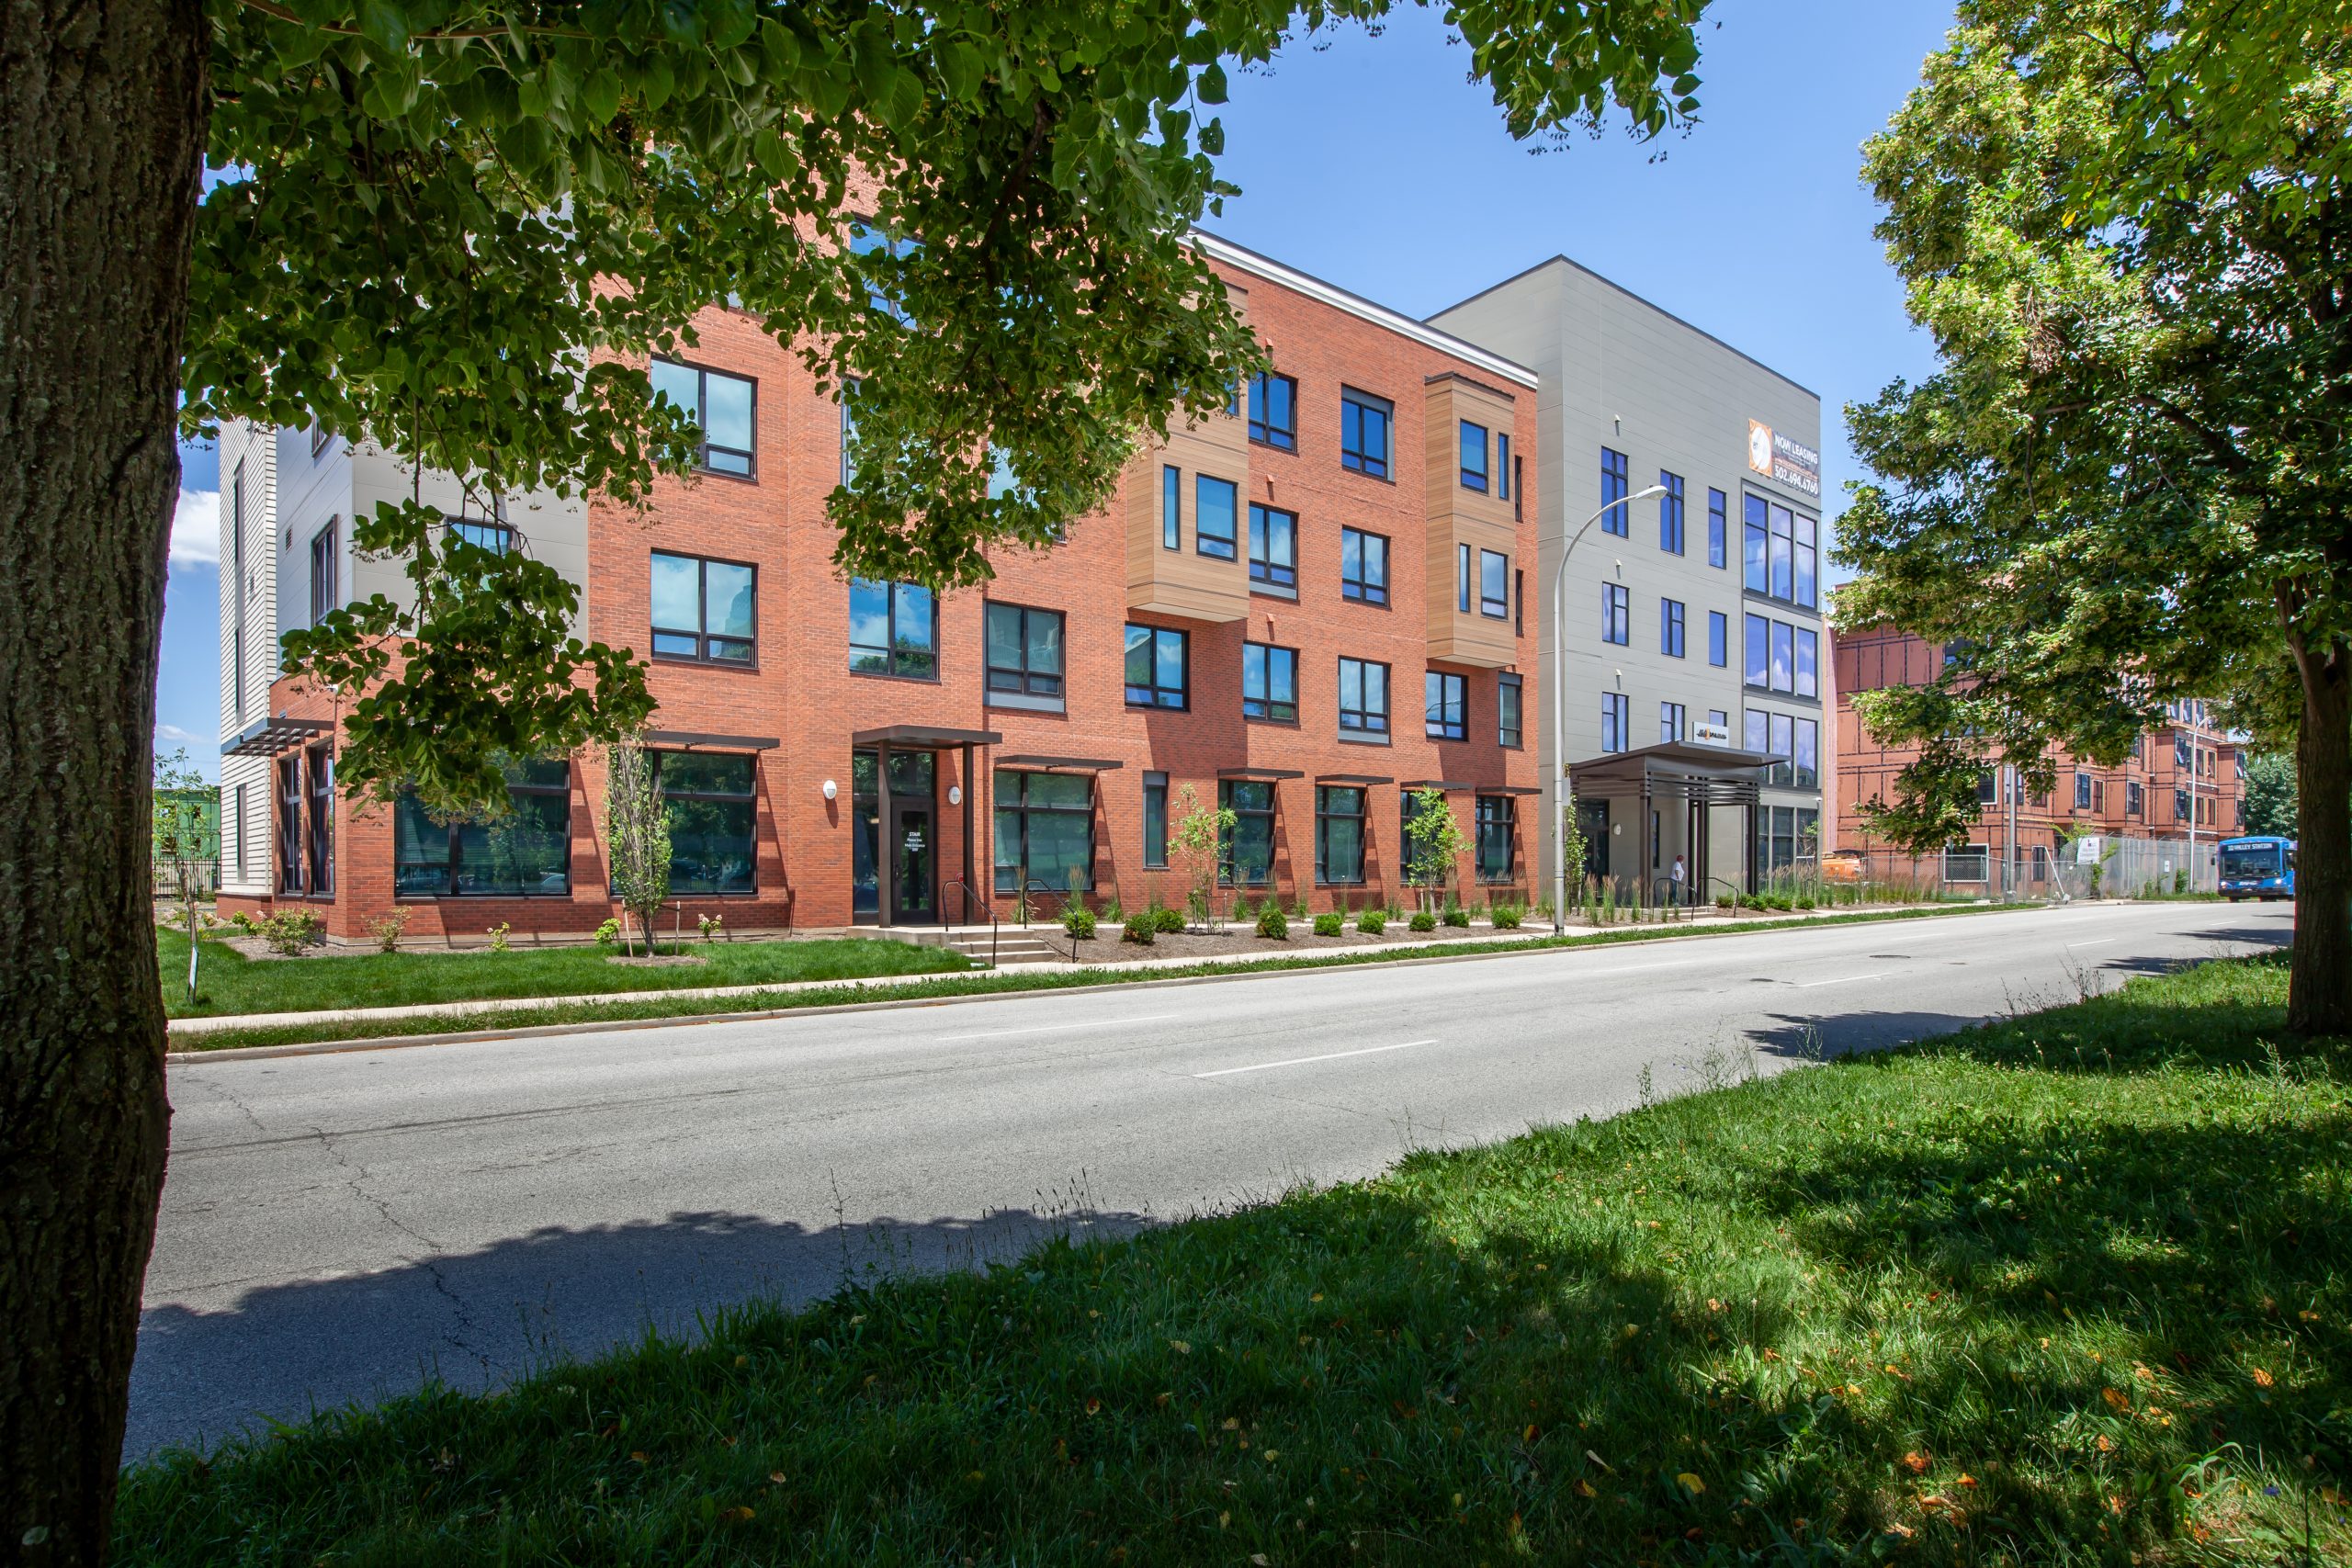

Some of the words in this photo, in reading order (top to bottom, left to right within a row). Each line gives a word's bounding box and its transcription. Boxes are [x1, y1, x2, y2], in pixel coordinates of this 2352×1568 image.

[1774, 434, 1792, 452] NOW
[1792, 443, 1818, 465] LEASING
[1774, 465, 1818, 495] 502.694.6760
